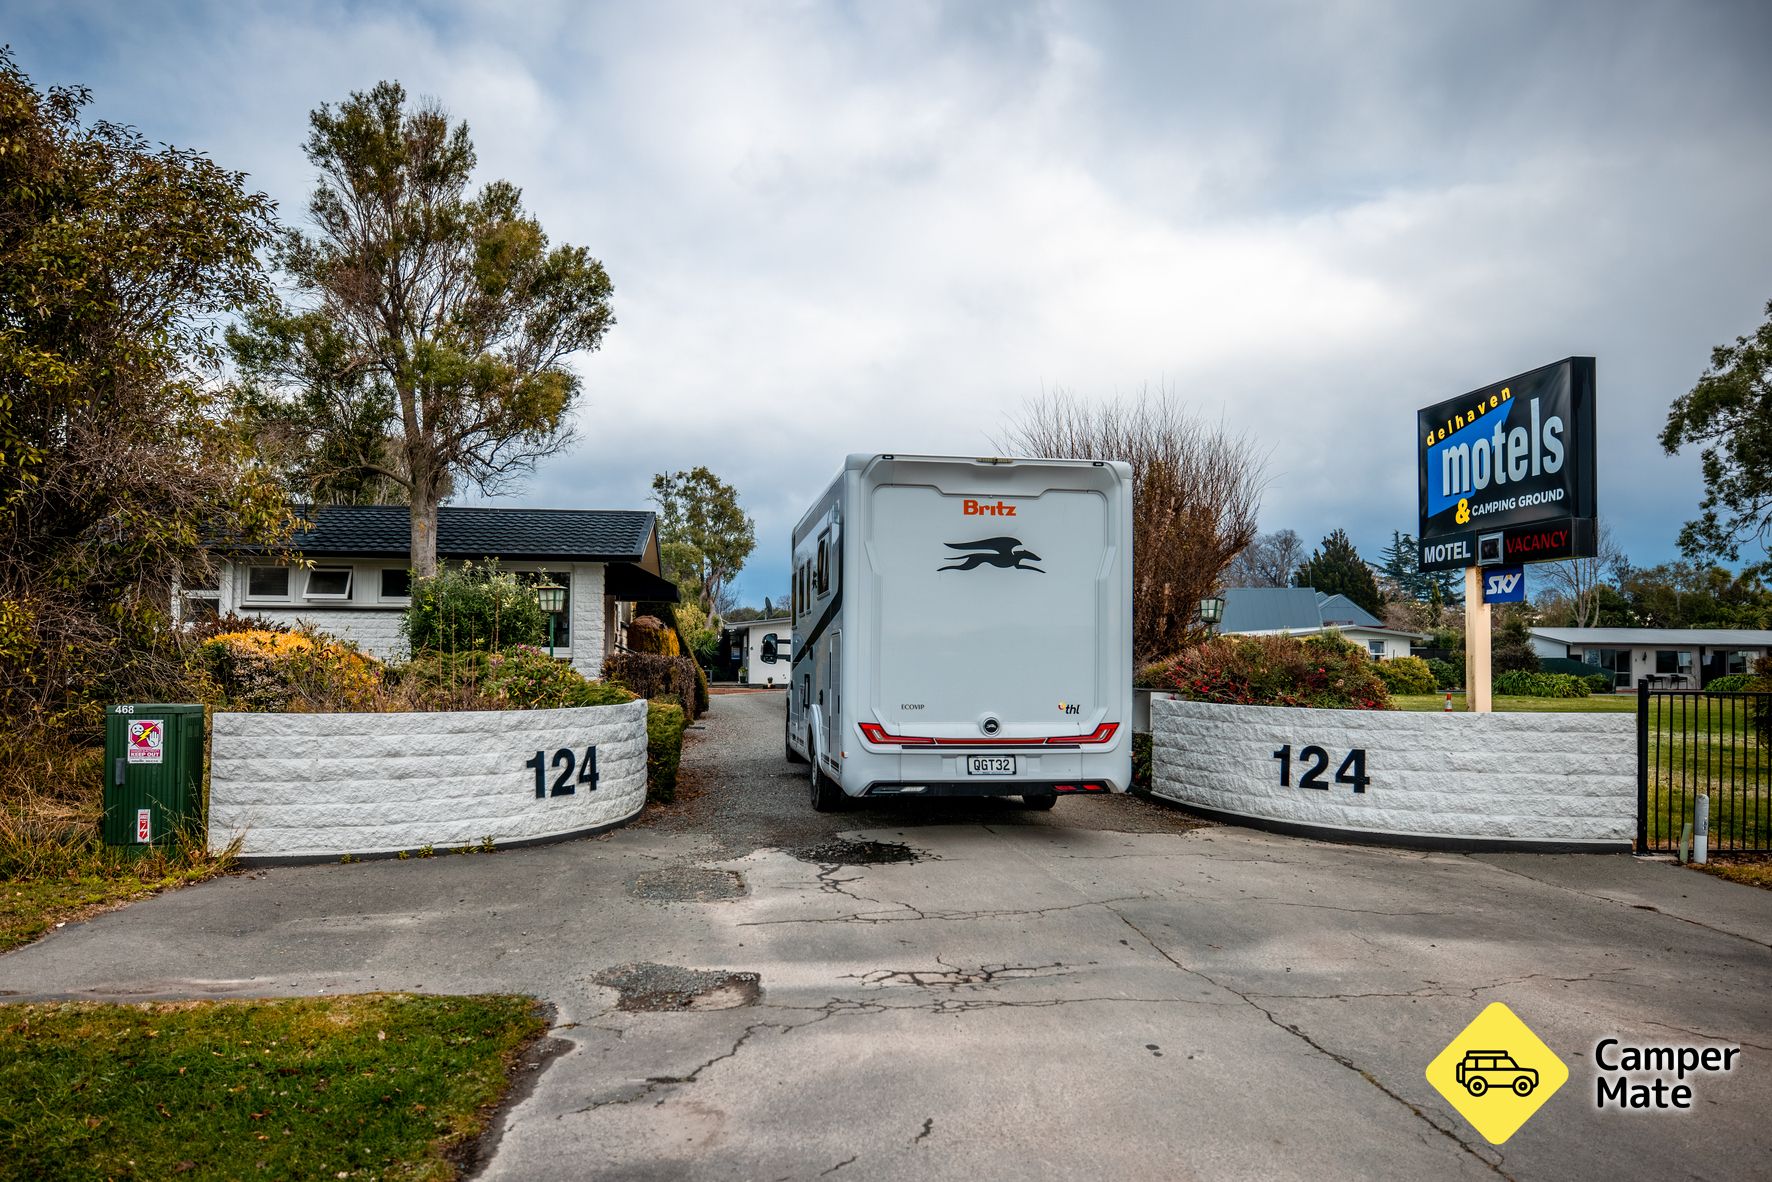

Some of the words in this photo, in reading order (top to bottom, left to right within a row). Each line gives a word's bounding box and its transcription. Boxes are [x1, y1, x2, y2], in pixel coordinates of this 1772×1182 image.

[1426, 387, 1511, 446] delhaven
[1442, 397, 1565, 496] motels
[963, 499, 1017, 517] Britz
[1455, 498, 1471, 525] &
[1472, 498, 1516, 516] CAMPING
[1518, 488, 1564, 507] GROUND
[1424, 541, 1471, 564] MOTEL
[1506, 530, 1568, 554] VACANCY
[1486, 573, 1522, 595] SKY
[115, 705, 134, 714] 468
[1065, 704, 1080, 714] thl
[526, 746, 599, 799] 124
[973, 759, 1010, 771] QGT32
[1273, 745, 1370, 793] 124
